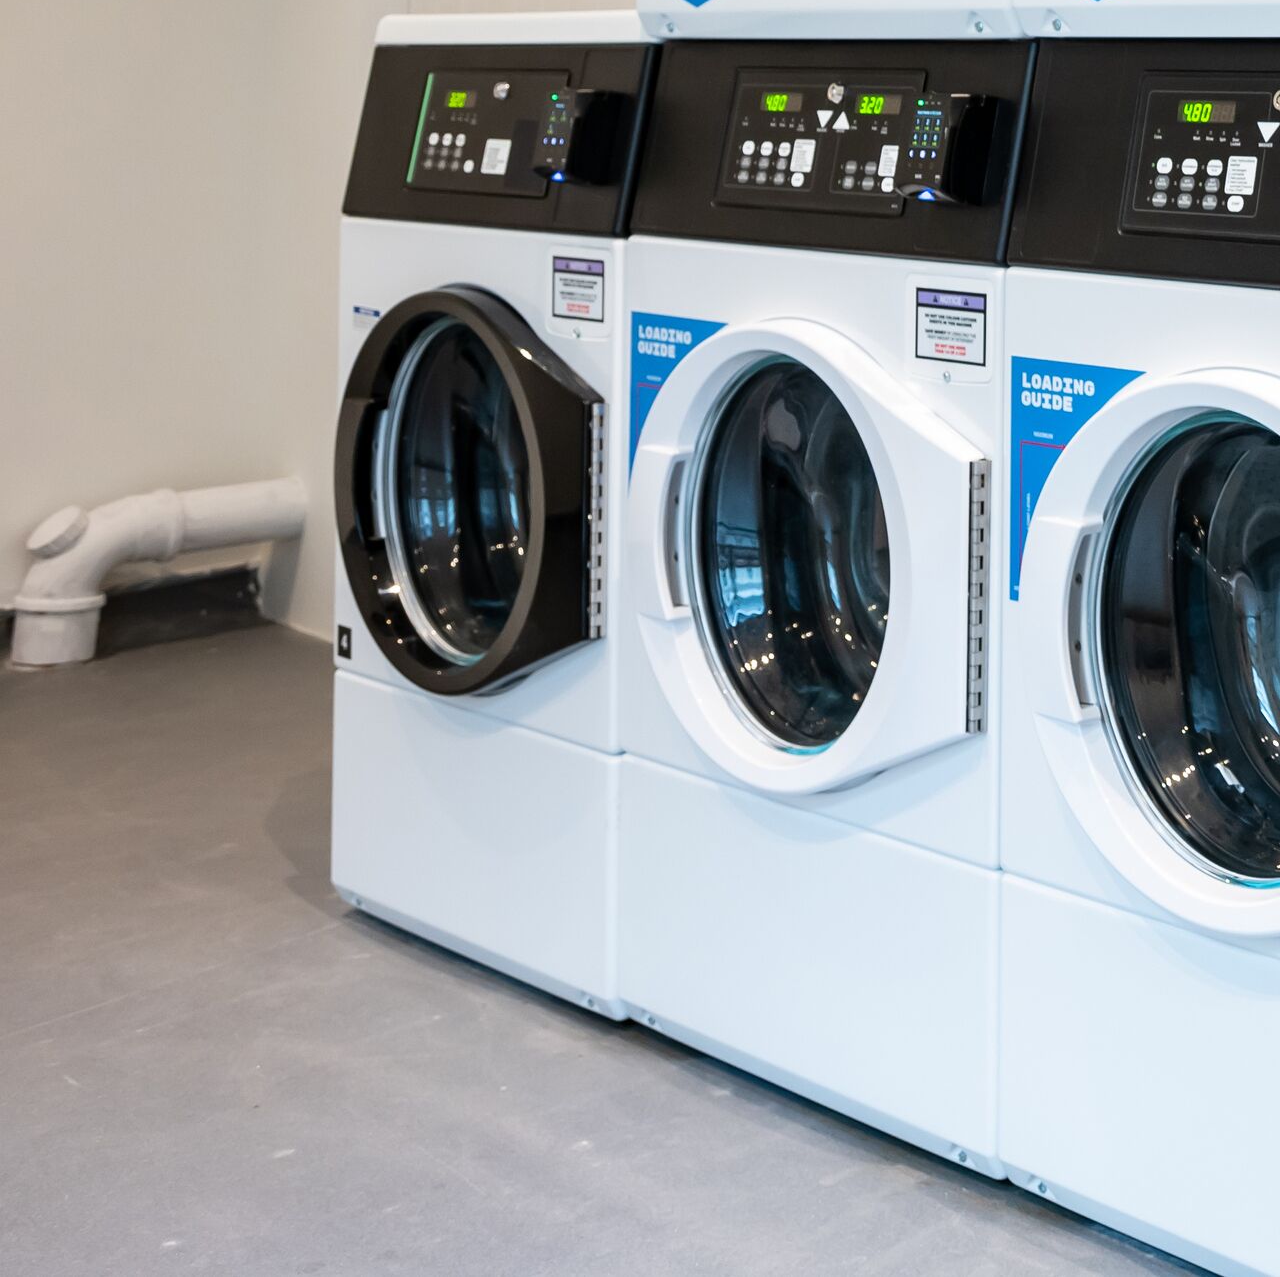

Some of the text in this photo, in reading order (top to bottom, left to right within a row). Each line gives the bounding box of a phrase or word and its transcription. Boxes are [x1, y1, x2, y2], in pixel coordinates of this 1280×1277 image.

[1184, 103, 1212, 122] 4.80
[638, 325, 692, 347] LOADING
[638, 339, 678, 358] GUIDE
[1021, 372, 1095, 397] LOADING
[1021, 391, 1073, 412] GUIDE
